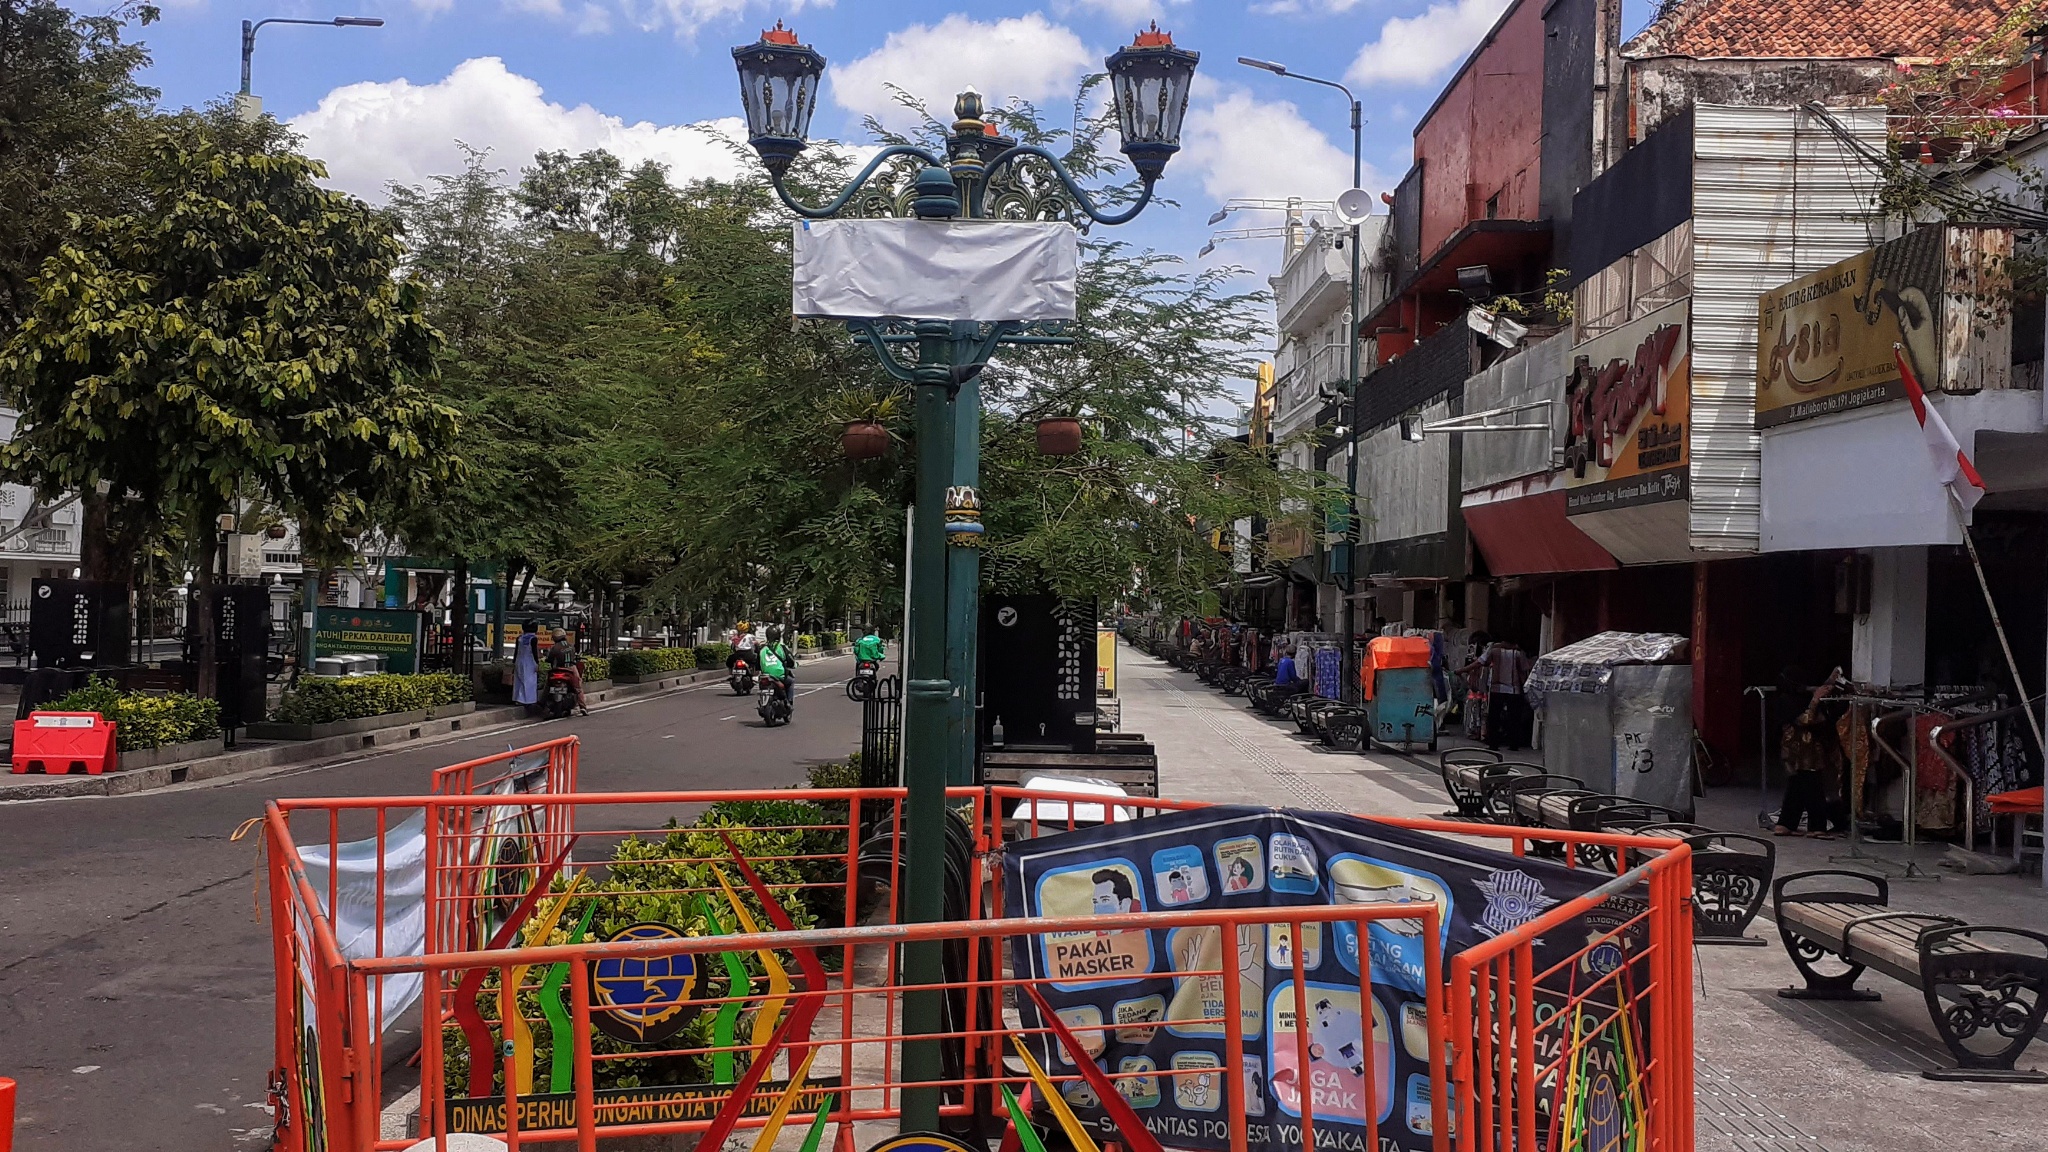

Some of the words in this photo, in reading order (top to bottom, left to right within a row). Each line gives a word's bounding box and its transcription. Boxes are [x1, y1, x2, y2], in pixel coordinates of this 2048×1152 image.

[1848, 386, 1886, 406] Jogjakarta
[315, 630, 341, 640] ATUHI
[343, 631, 368, 641] PPKM
[370, 633, 411, 643] DARURAT
[1631, 749, 1654, 774] 13
[1056, 938, 1112, 961] PAKAI
[1058, 954, 1135, 978] MASKER
[1118, 1007, 1147, 1019] SEDANG
[1202, 1000, 1224, 1008] TIDA
[1203, 1008, 1259, 1018] BERSMAN
[1284, 1020, 1310, 1028] METR
[1286, 1068, 1343, 1090] JGA
[1287, 1086, 1357, 1110] JRAK
[452, 1102, 507, 1133] DINAS
[517, 1094, 654, 1129] PERHUUNGAN
[658, 1090, 706, 1120] KOTA
[1099, 1116, 1198, 1137] SAANTAS
[1276, 1123, 1401, 1152] YOYAKATA
